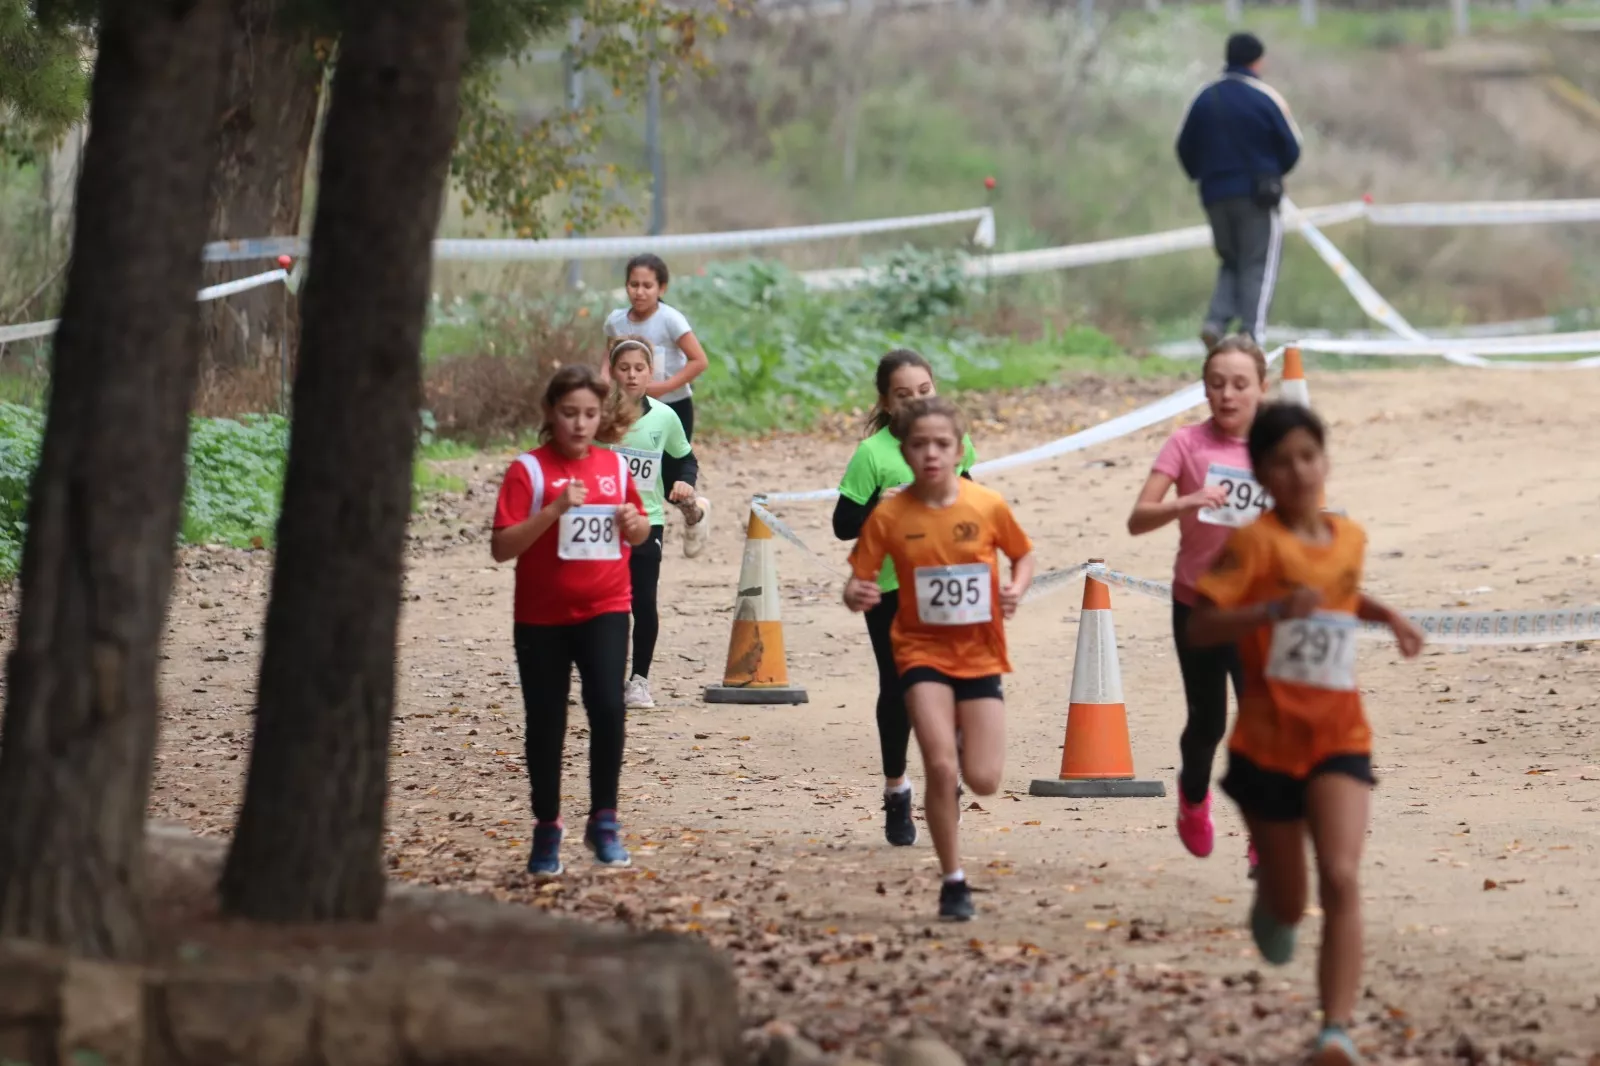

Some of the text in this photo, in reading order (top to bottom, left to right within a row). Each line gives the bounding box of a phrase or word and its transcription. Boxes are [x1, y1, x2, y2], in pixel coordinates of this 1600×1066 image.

[622, 455, 653, 479] 96
[571, 517, 613, 543] 298
[929, 578, 980, 607] 295
